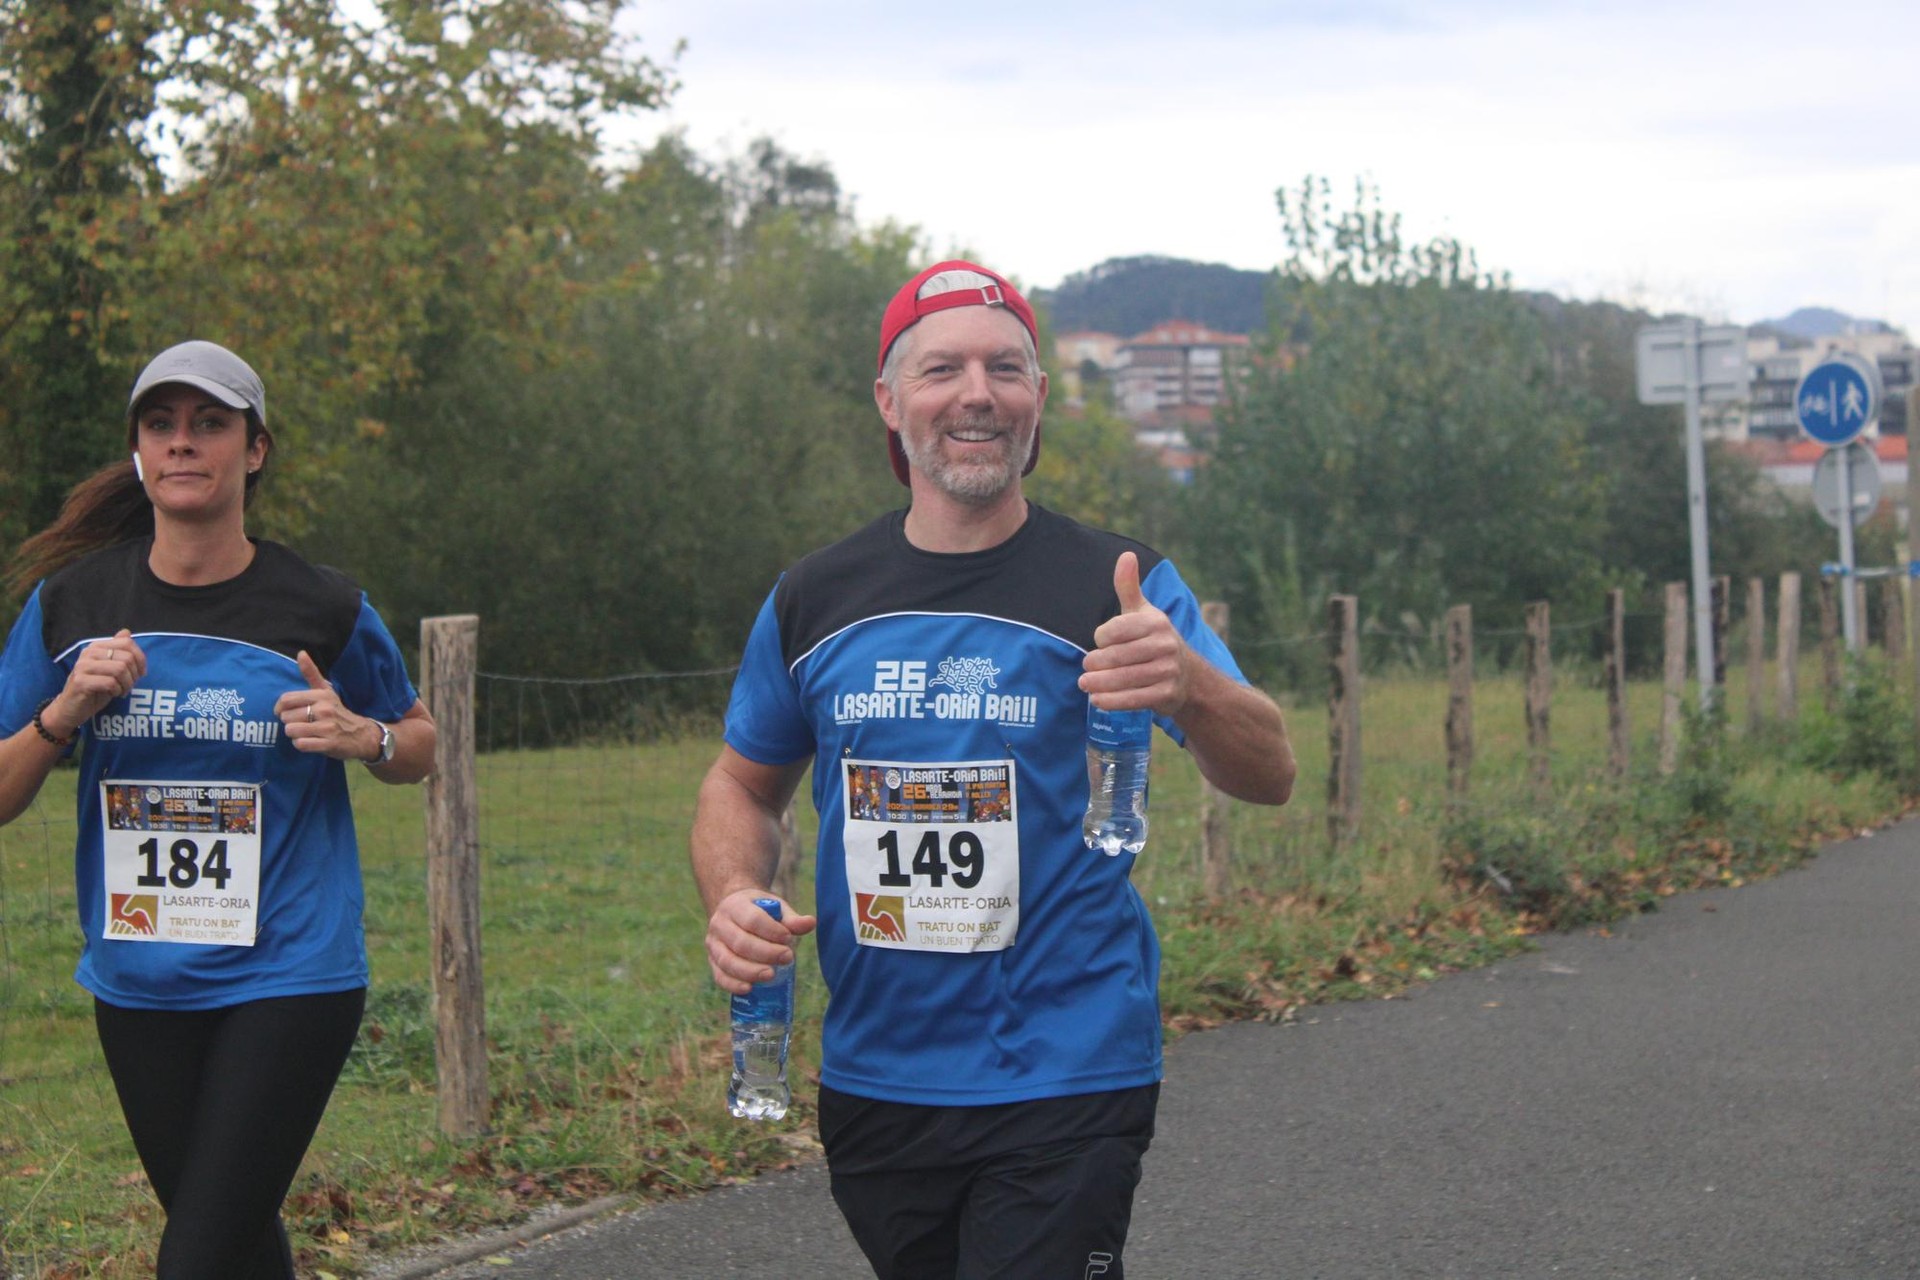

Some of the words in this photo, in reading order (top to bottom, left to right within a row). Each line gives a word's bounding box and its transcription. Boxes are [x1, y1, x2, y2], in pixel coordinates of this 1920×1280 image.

[874, 661, 927, 691] 26
[129, 688, 177, 716] 26
[137, 837, 231, 889] 184
[877, 830, 984, 889] 149
[163, 895, 251, 909] LASARTE-ORIA
[909, 896, 1011, 910] LASARTE-ORIA
[169, 917, 200, 927] TRATU
[203, 918, 218, 928] ON
[221, 919, 241, 928] BAT
[917, 921, 954, 932] TRATU
[957, 922, 975, 933] ON
[979, 921, 1002, 932] BAT
[920, 935, 934, 945] UN
[936, 936, 961, 946] BUEN
[966, 934, 1000, 946] TRATO
